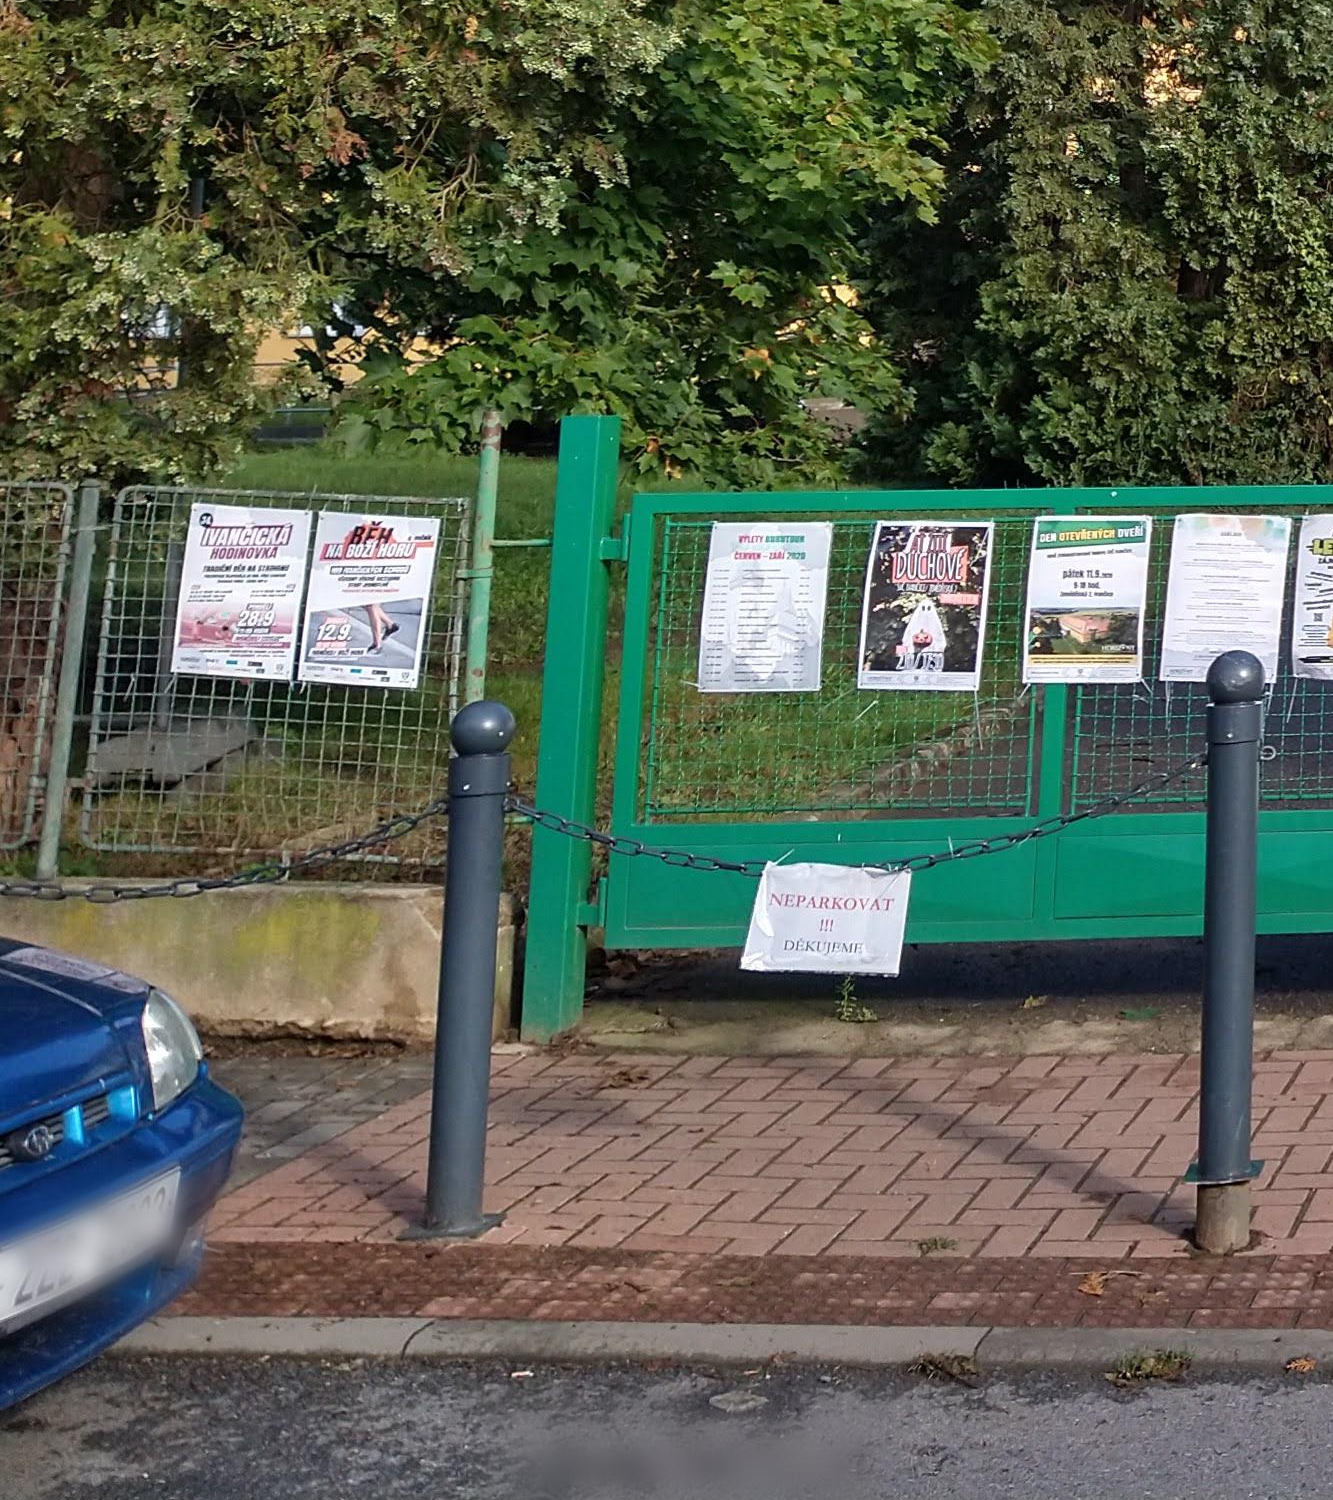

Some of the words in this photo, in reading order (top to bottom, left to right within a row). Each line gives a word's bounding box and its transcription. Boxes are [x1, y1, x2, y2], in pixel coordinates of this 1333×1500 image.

[201, 522, 293, 546] IVANČICKÁ
[349, 521, 394, 545] BĚH
[1040, 533, 1057, 543] DEN
[1059, 528, 1115, 541] OTEVŘENÝCH
[1117, 525, 1144, 538] DVEŘÍ
[210, 547, 279, 560] HODINOVKA
[325, 544, 343, 560] NA
[345, 540, 378, 560] BOŽÍ
[377, 542, 416, 560] HORU
[317, 624, 353, 641] 12.9.
[769, 893, 895, 911] NEPARKOVAT
[819, 919, 834, 932] !!!
[784, 938, 864, 956] DĚKUJEME
